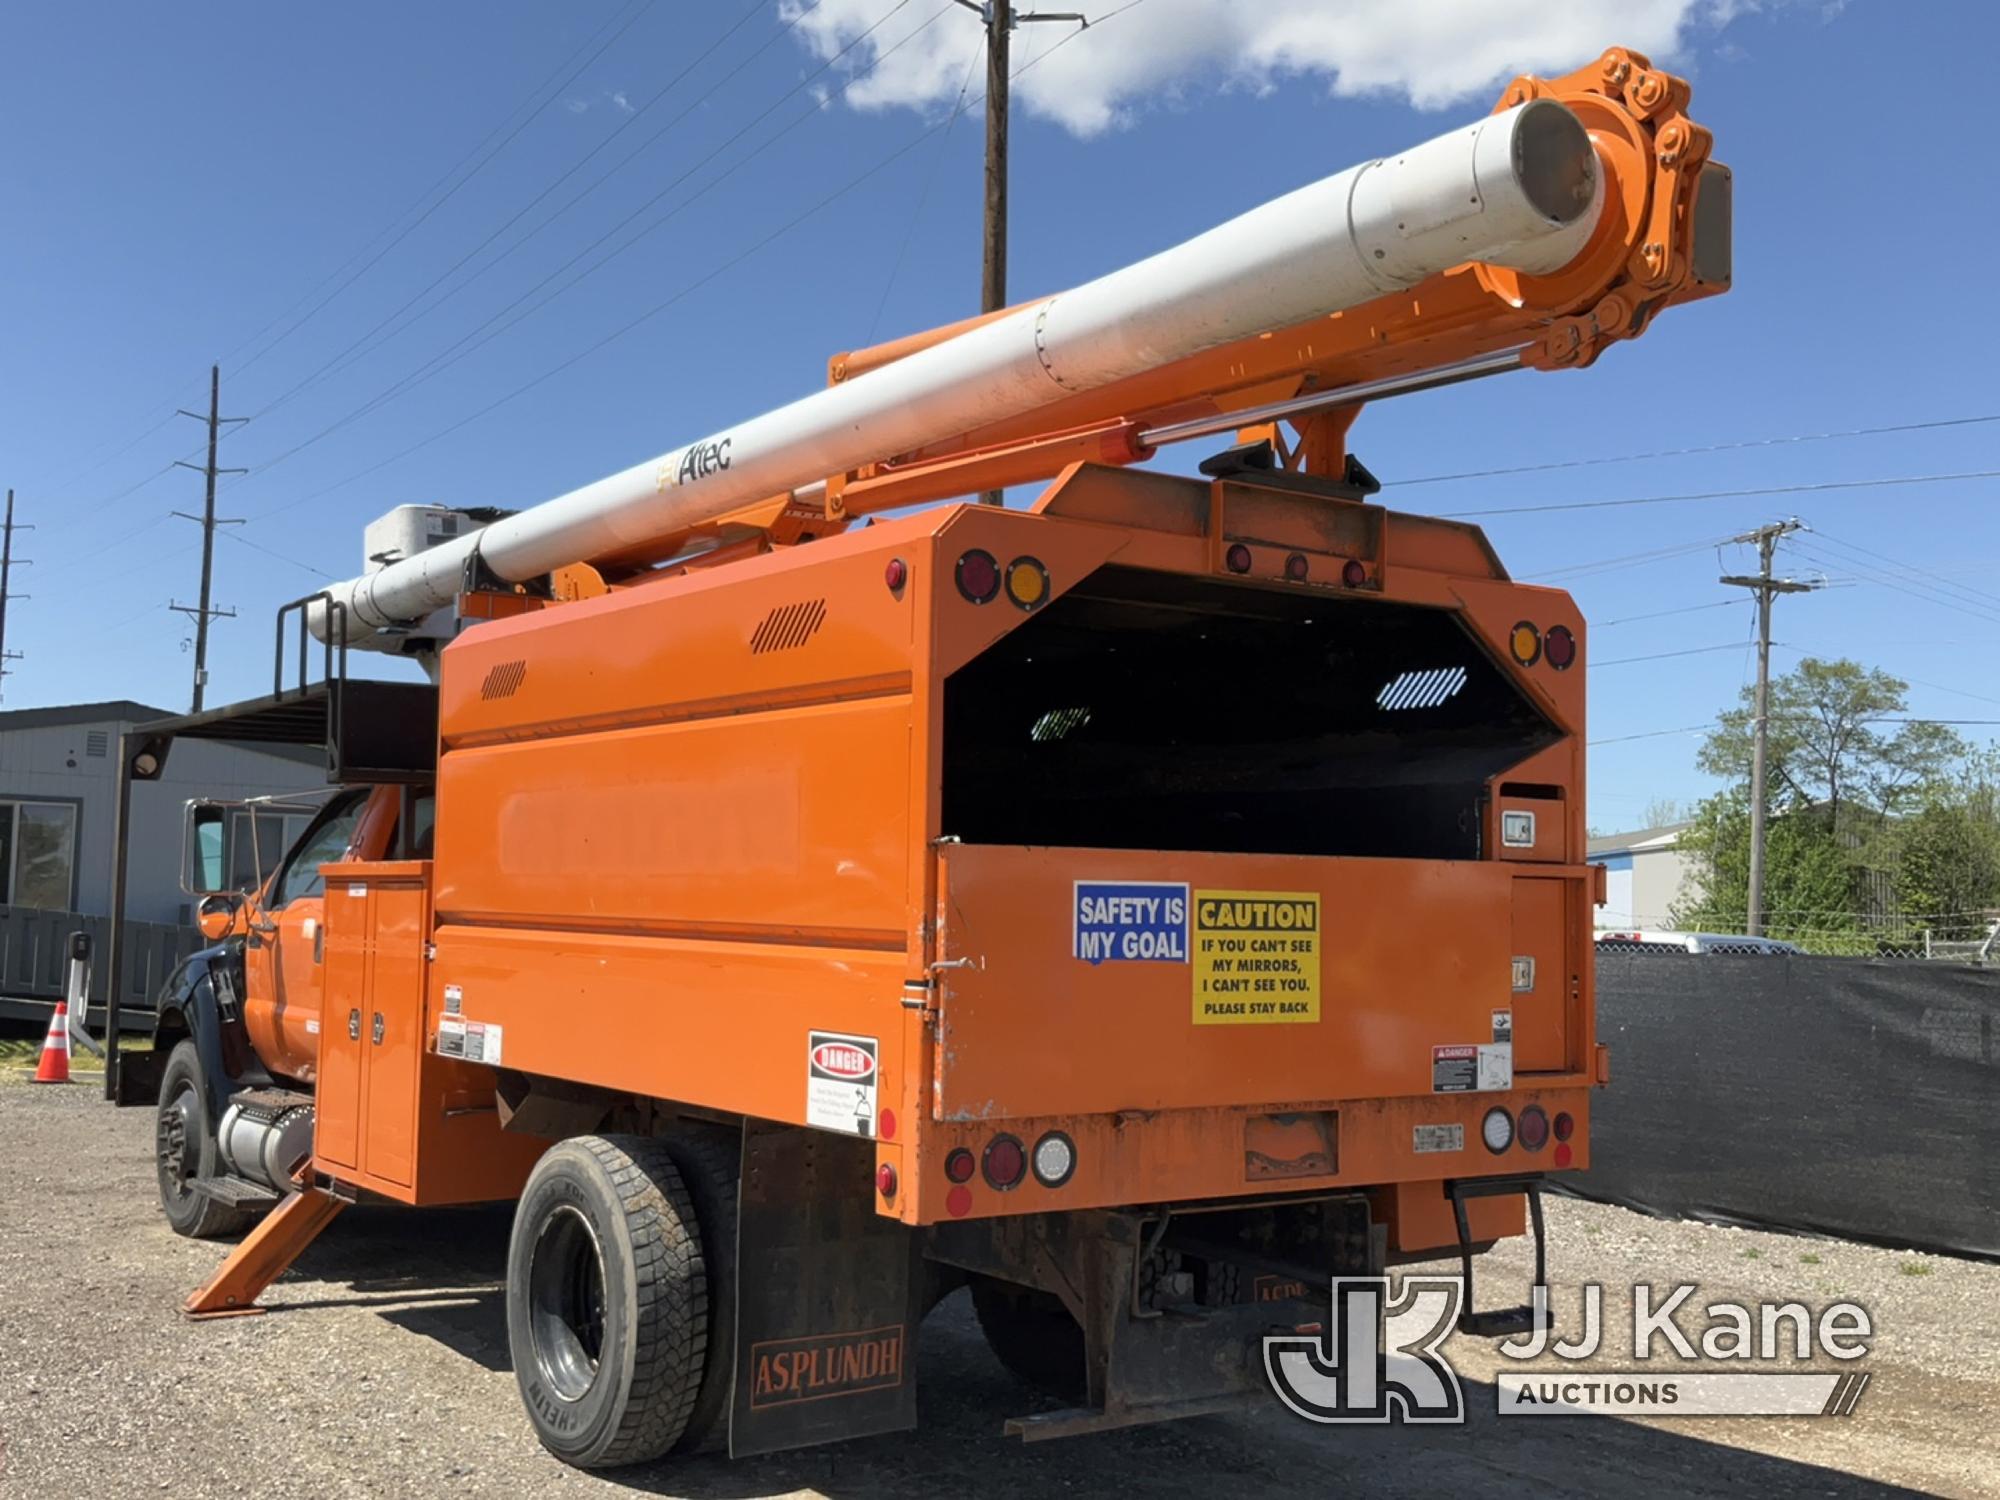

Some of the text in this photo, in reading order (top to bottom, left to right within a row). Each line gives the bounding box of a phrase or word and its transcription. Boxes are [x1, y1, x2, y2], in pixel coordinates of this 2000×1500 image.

[679, 437, 731, 485] Altec
[1080, 897, 1184, 925] SAFETY IS
[1200, 902, 1313, 928] CAUTION
[1080, 931, 1183, 959] MY GOAL
[1201, 939, 1312, 952] IF YOU CAN'T SEE
[1212, 959, 1301, 974] MY MIRRORS,
[1203, 979, 1310, 992] I CAN'T SEE YOU.
[1205, 1002, 1308, 1015] PLEASE STAY BACK
[821, 1048, 864, 1073] DANGER
[1445, 1048, 1473, 1057] DANGER
[755, 1338, 899, 1395] ASPLUNDH
